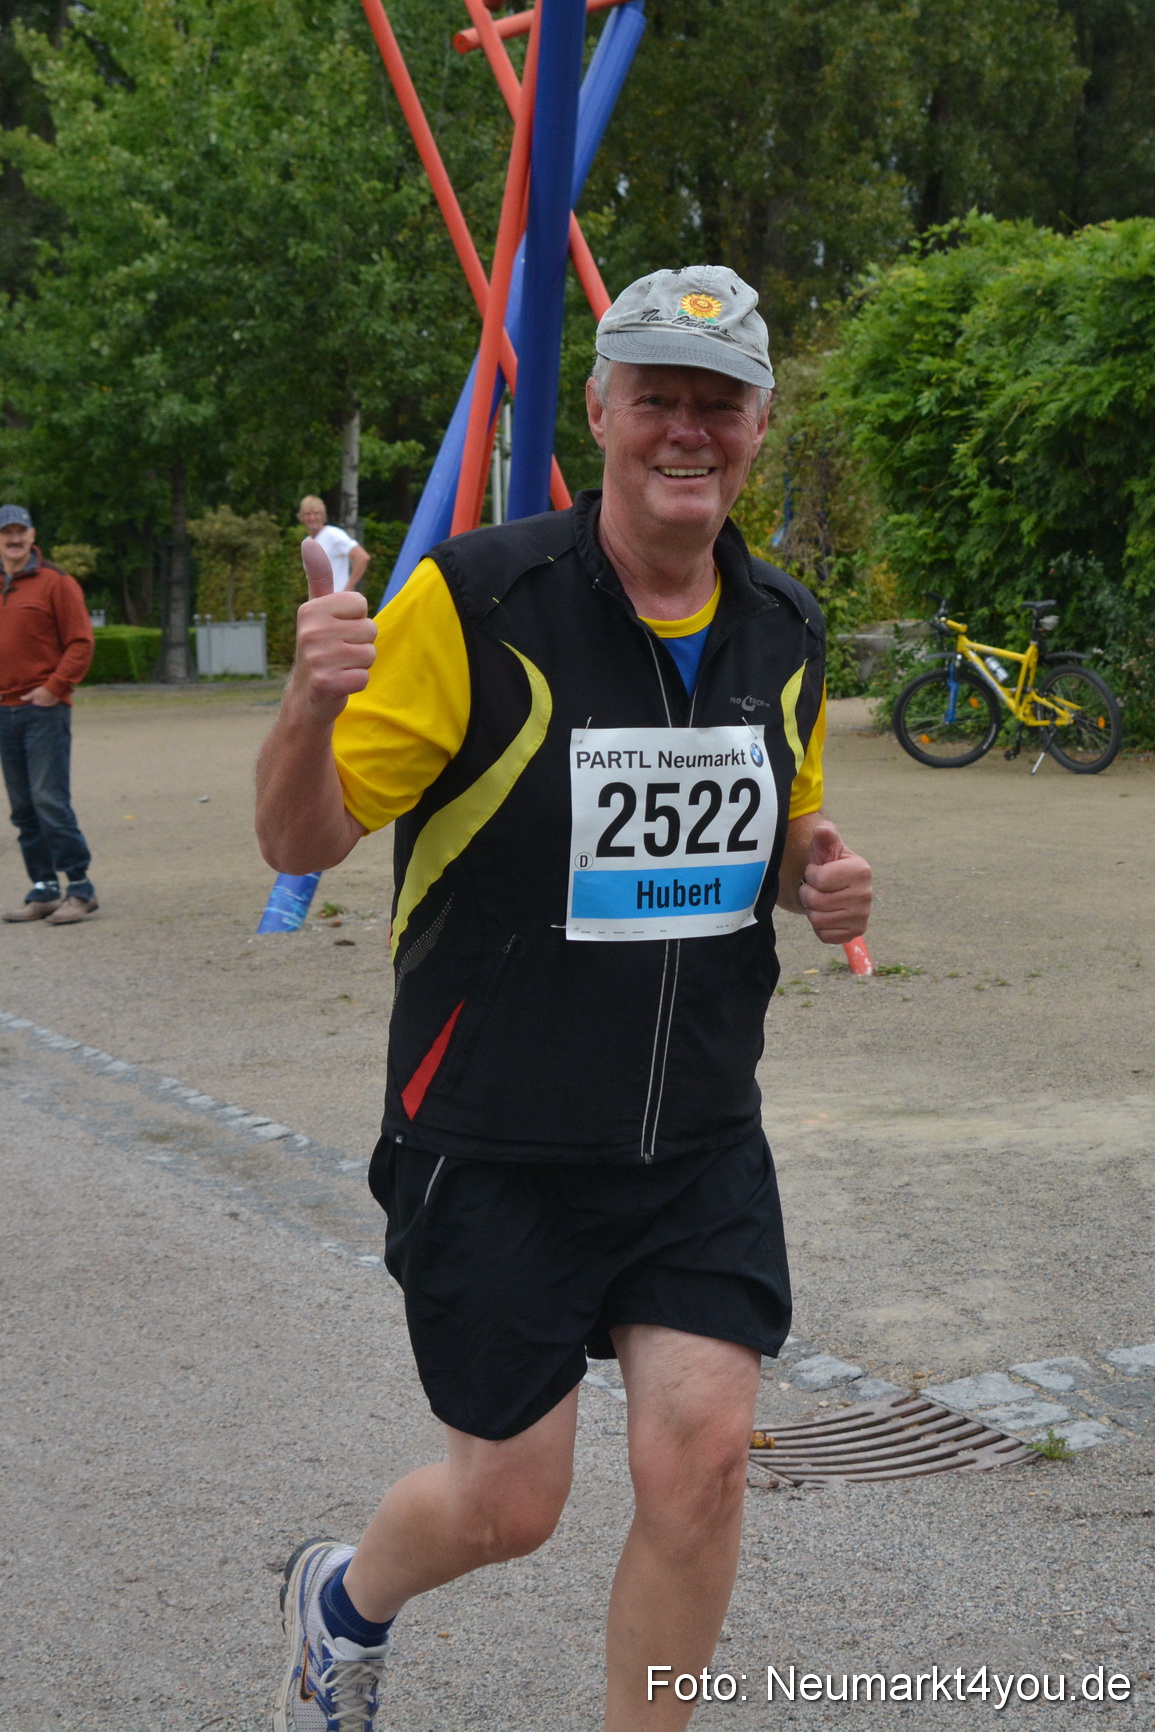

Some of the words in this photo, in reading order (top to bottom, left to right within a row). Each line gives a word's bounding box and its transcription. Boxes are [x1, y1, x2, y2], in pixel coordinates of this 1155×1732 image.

[576, 751, 652, 768] PARTL
[659, 749, 747, 768] Neumarkt
[596, 778, 761, 858] 2522
[580, 855, 588, 867] D
[637, 878, 721, 909] Hubert
